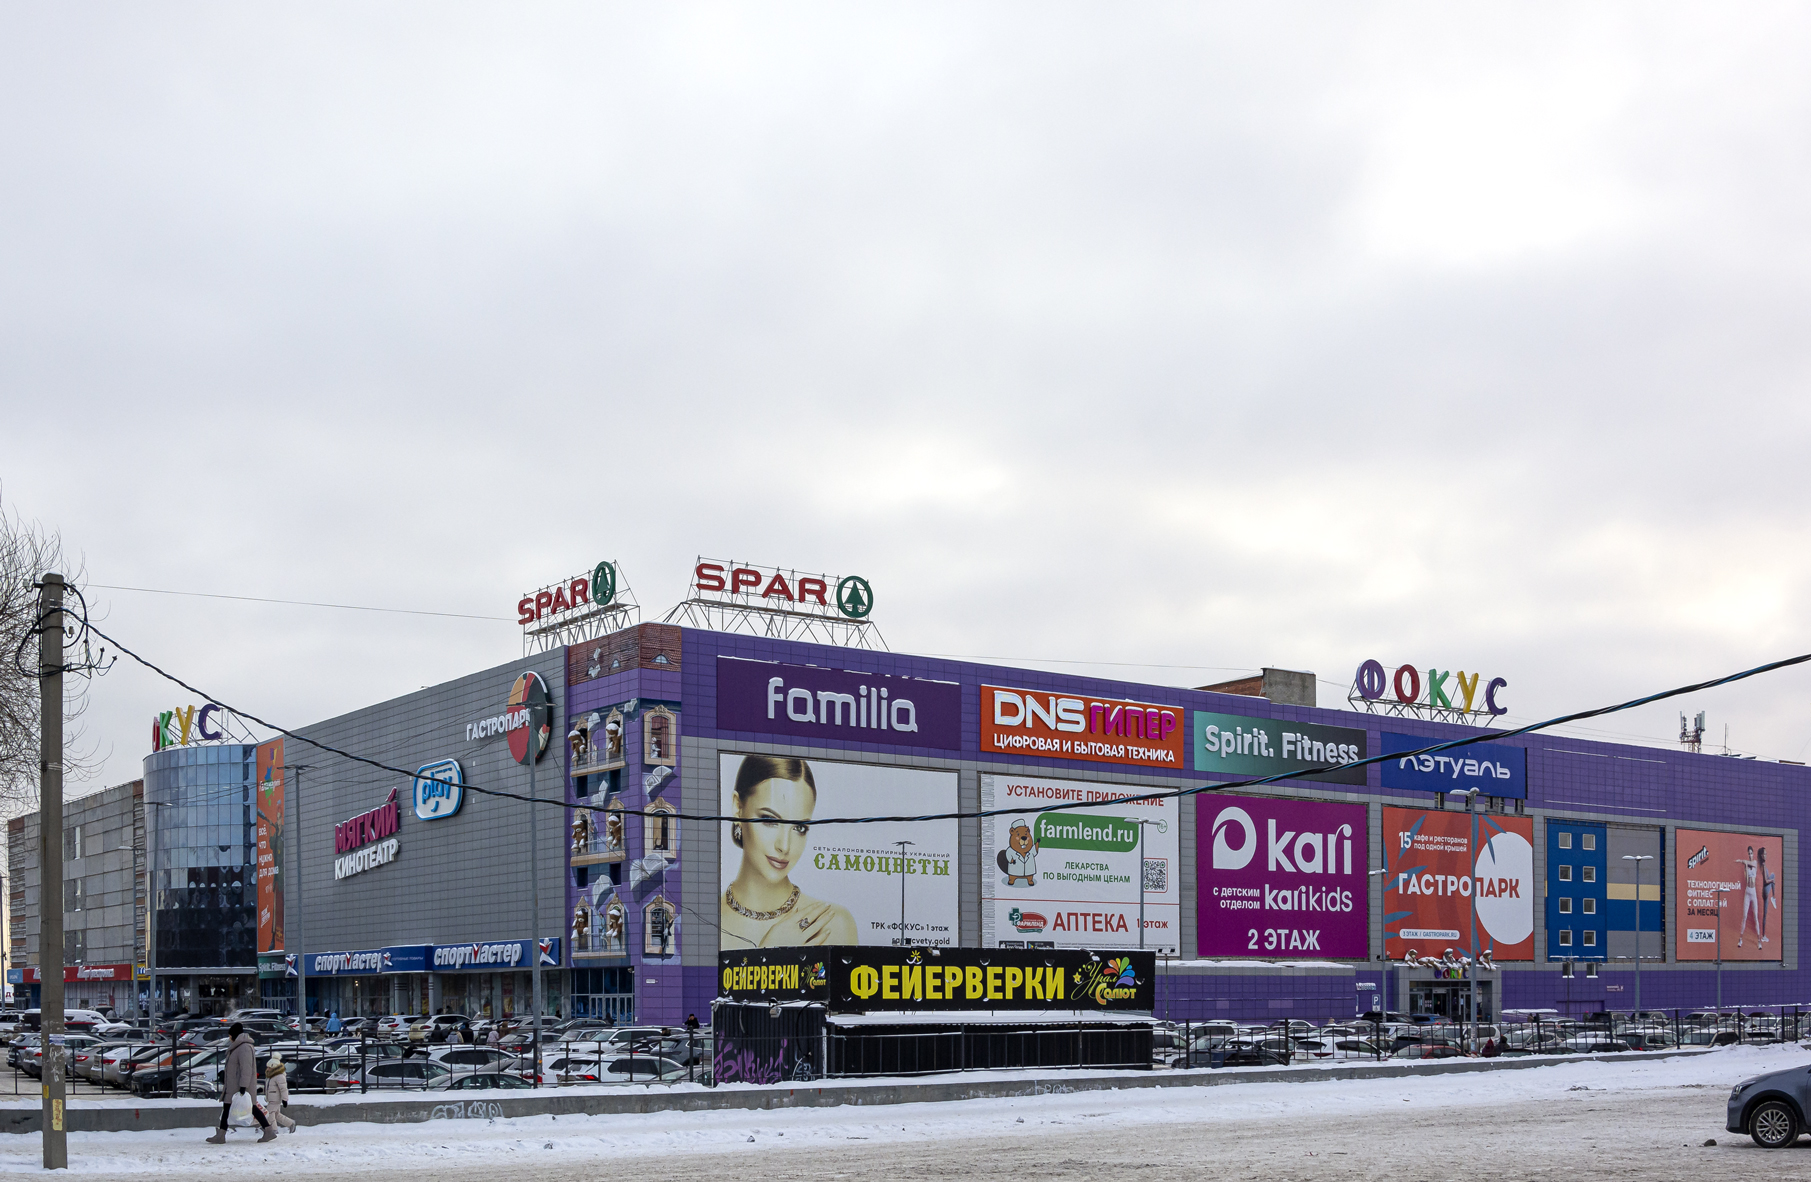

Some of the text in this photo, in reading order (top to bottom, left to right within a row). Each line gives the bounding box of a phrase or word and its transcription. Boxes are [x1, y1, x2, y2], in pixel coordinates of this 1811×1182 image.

[696, 563, 827, 606] SPAR
[518, 578, 588, 625] SPAR
[1357, 659, 1507, 715] ФОКУС
[767, 677, 918, 733] familia
[994, 690, 1176, 740] DNS ГИПЕР
[994, 733, 1175, 762] ЦИФРОВАЯ И БЫТОВАЯ ТЕХНИКА
[1205, 725, 1359, 764] Spirit. Fitness
[422, 772, 453, 804] play
[1007, 784, 1083, 801] УСТАНОВИТЕ
[335, 787, 398, 854] МЯГКИЙ
[1040, 819, 1134, 842] farmlend.ru
[1268, 819, 1352, 875] kari
[1399, 832, 1411, 848] 15
[1414, 834, 1428, 843] кафе
[1434, 836, 1467, 845] ресторанов
[1414, 843, 1425, 851] под
[1445, 845, 1467, 853] крышей
[335, 838, 399, 880] КИНОТЕАТР
[814, 853, 950, 875] САМОЦВЕТЫ
[1064, 862, 1109, 871] ЛЕКАРСТВА
[1043, 872, 1131, 884] ПО ВЫГОДНЫМ ЦЕНАМ
[1399, 873, 1520, 898] ГАСТРОПАРК
[1687, 880, 1741, 890] ТЕХНОЛОГИЧНЫЙ
[1213, 887, 1260, 897] с детским
[1687, 889, 1713, 898] ФИТНЕС
[1220, 900, 1260, 910] отделом
[1687, 908, 1695, 916] ЗА
[871, 922, 885, 930] ТРК
[1053, 912, 1129, 933] АПТЕКА
[1143, 920, 1169, 929] этаж
[1248, 929, 1321, 950] 2 ЭТАЖ
[1695, 932, 1714, 940] ЭТАЖ
[723, 959, 799, 991] ФЕЙЕРВЕРКИ
[850, 957, 1065, 1000] ФЕЙЕРВЕРКИ
